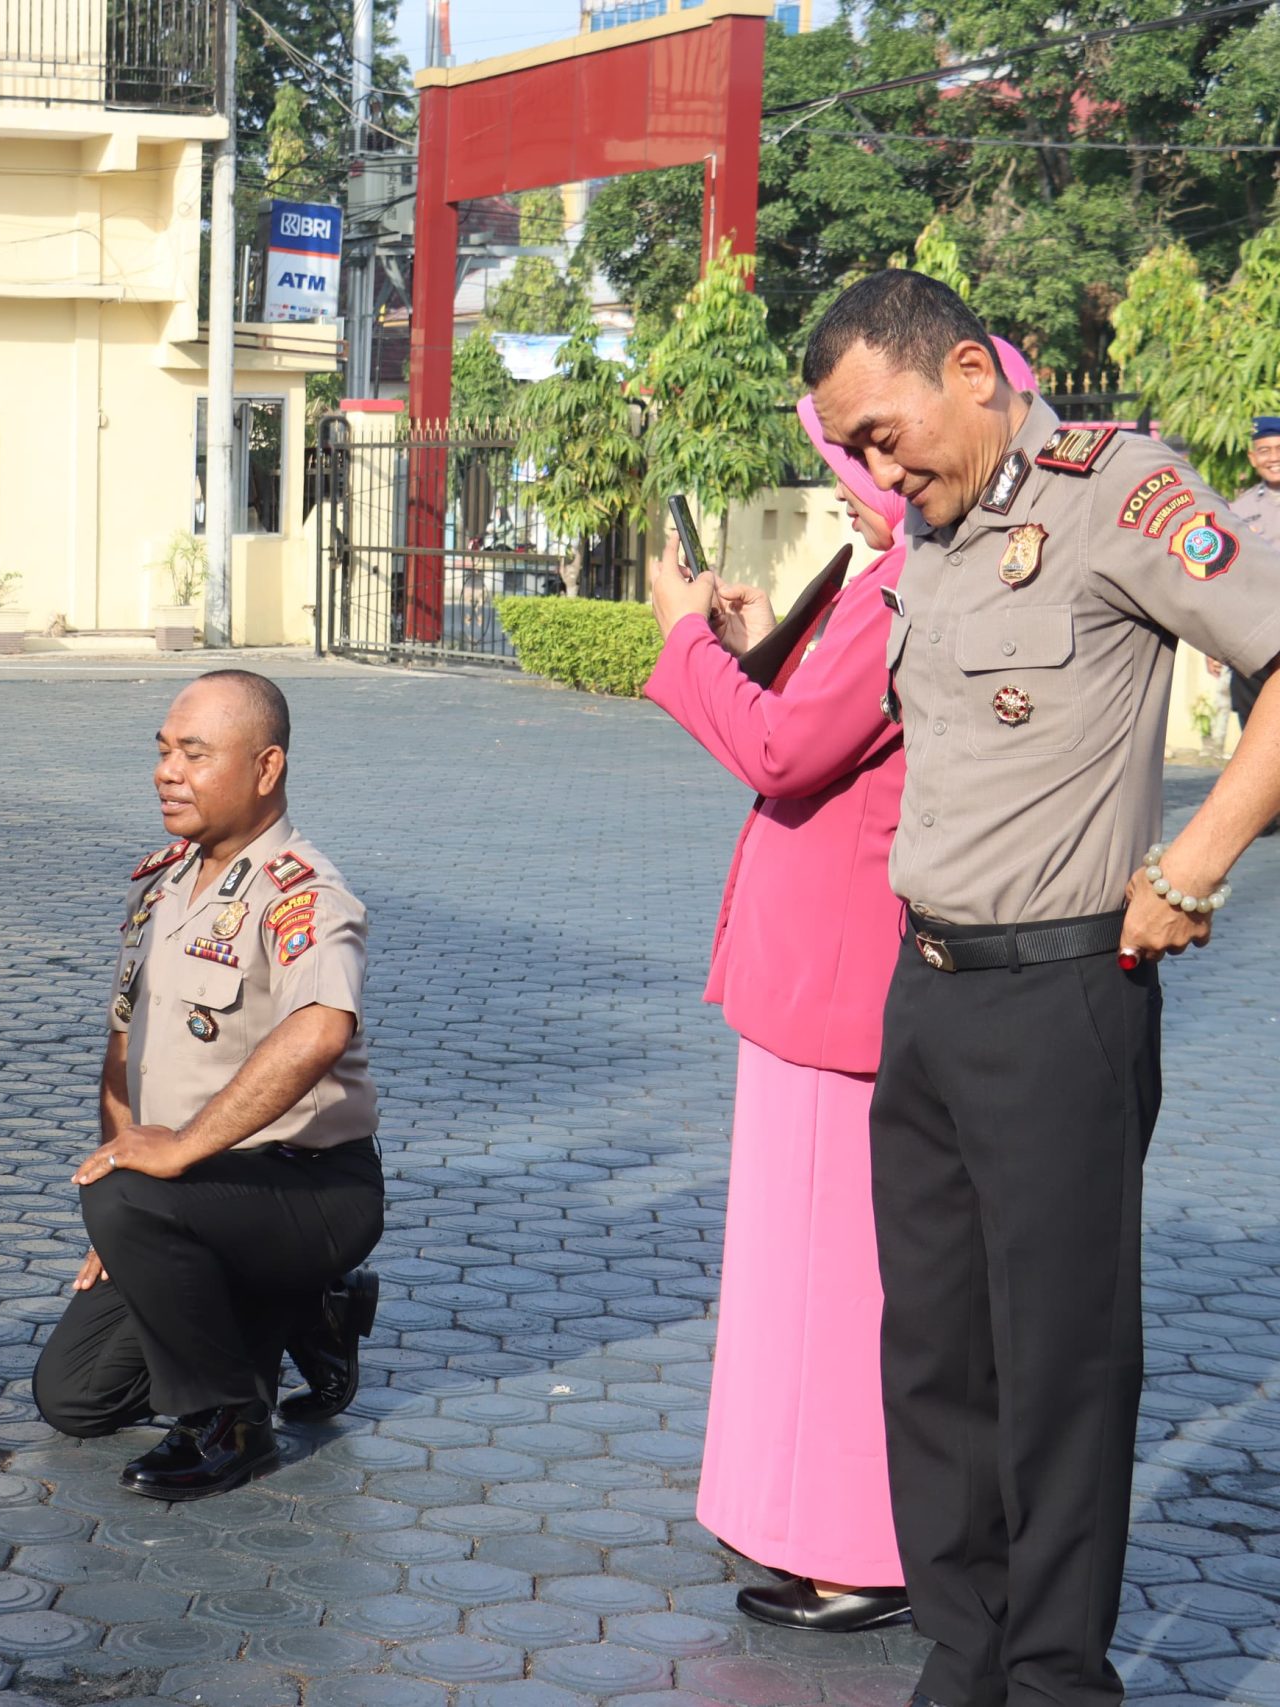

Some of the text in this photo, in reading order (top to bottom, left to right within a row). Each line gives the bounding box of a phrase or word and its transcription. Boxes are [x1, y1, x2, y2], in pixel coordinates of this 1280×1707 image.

[301, 217, 331, 239] BRI
[278, 272, 326, 291] ATM
[1123, 473, 1175, 523] POLDA
[1148, 494, 1190, 535] SUMATERA UTARA
